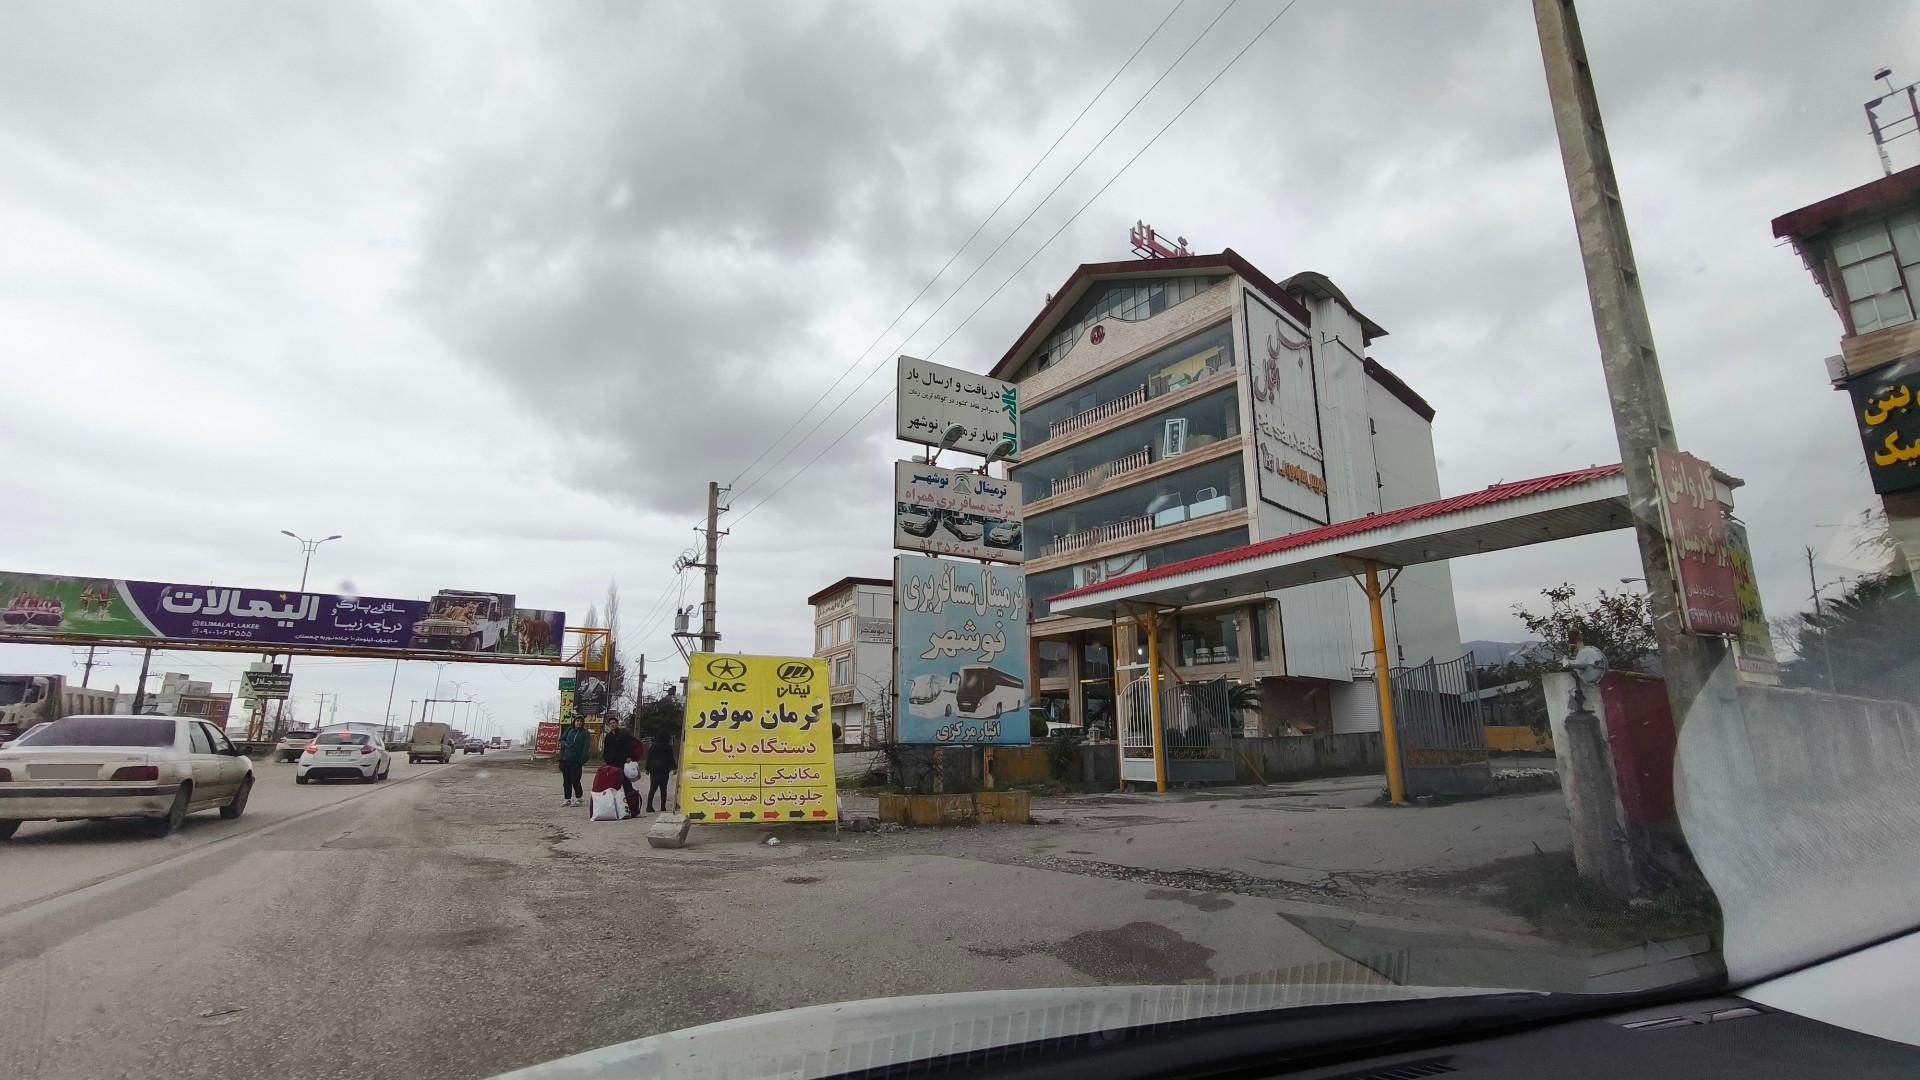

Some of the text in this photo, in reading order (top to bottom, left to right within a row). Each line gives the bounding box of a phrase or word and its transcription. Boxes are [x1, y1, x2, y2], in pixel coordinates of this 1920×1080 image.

[906, 368, 1000, 400] دریافت و ارسال بار
[906, 417, 939, 433] نوشهر
[979, 429, 998, 445] انبار
[911, 473, 1008, 499] ترمینال نوشهر
[1665, 459, 1714, 511] کارواش
[905, 488, 935, 505] همراه
[987, 503, 1016, 521] شرکت
[974, 567, 1024, 621] ترمینال
[162, 589, 320, 628] الیمالات
[336, 598, 371, 614] پارک
[334, 616, 403, 634] دریاچه زیبا
[919, 618, 1007, 664] نوشهر
[704, 682, 747, 693] JAC
[777, 684, 811, 698] لیفان
[692, 701, 824, 731] کرمان موتور
[935, 720, 1001, 742] انبار مرکزی
[698, 736, 817, 759] دستگاه دیاگ
[721, 771, 758, 784] گیربکس
[764, 768, 821, 785] مکانیکی
[693, 791, 758, 806] هیدرولیک
[763, 789, 823, 806] جلوبندی
